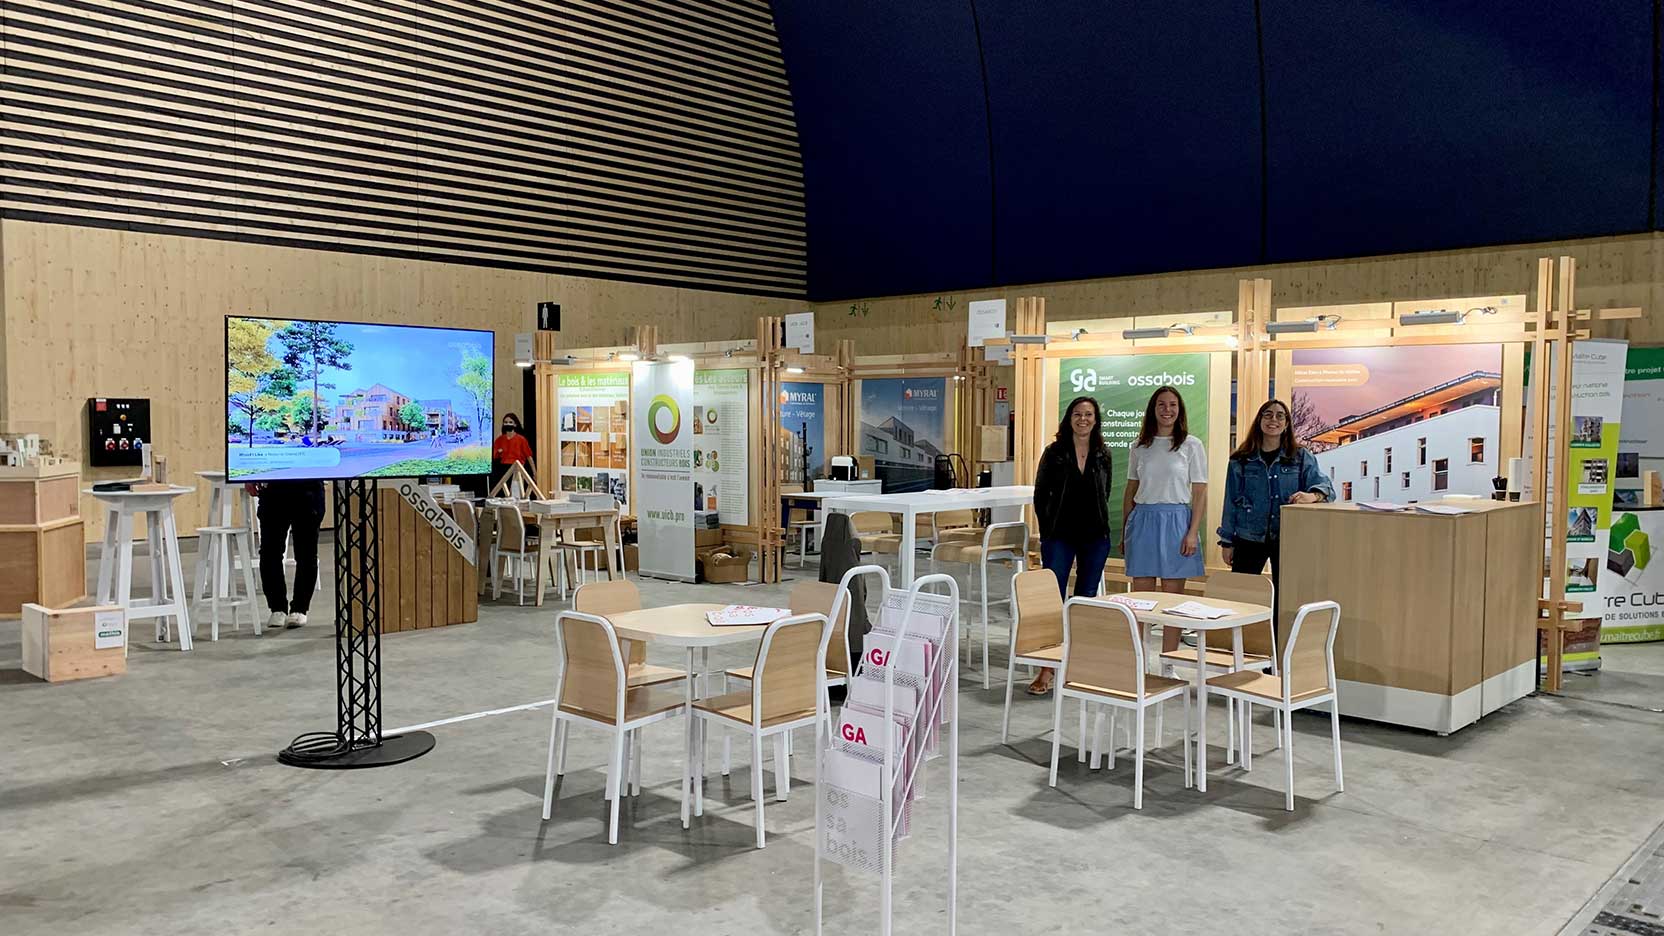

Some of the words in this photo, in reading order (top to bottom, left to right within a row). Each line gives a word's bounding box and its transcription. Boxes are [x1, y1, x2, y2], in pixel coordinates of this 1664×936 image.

[1637, 366, 1661, 375] projet
[567, 375, 580, 386] bois
[1128, 371, 1195, 386] ossabois
[1107, 410, 1135, 418] Chaque
[641, 449, 656, 457] UNION
[657, 449, 690, 458] INDUSTRIELS
[641, 458, 678, 467] CONSTRUCTEURS
[679, 459, 690, 467] BOIS
[400, 484, 465, 549] ossabois
[647, 508, 685, 522] www.uicb.pro
[1619, 611, 1659, 620] SOLUTIONS
[842, 724, 867, 745] GA
